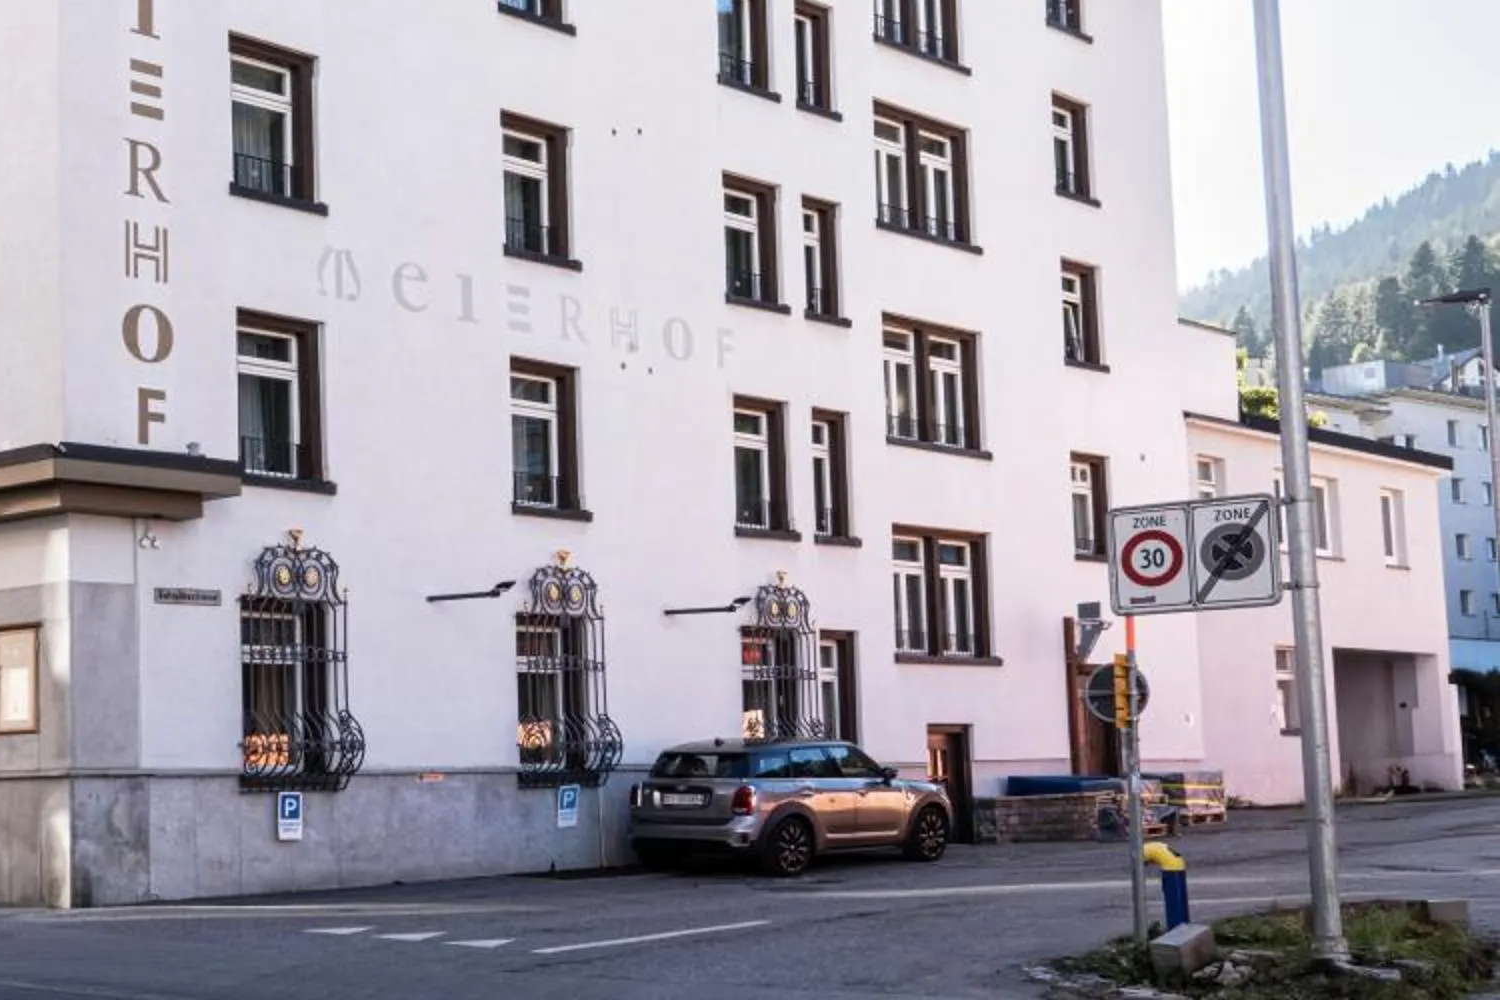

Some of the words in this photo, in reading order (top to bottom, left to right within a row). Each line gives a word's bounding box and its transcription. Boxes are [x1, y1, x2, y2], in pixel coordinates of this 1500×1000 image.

[1132, 515, 1167, 529] ZONE
[1214, 508, 1250, 522] ZONE
[1139, 548, 1165, 569] 30
[285, 797, 298, 817] P
